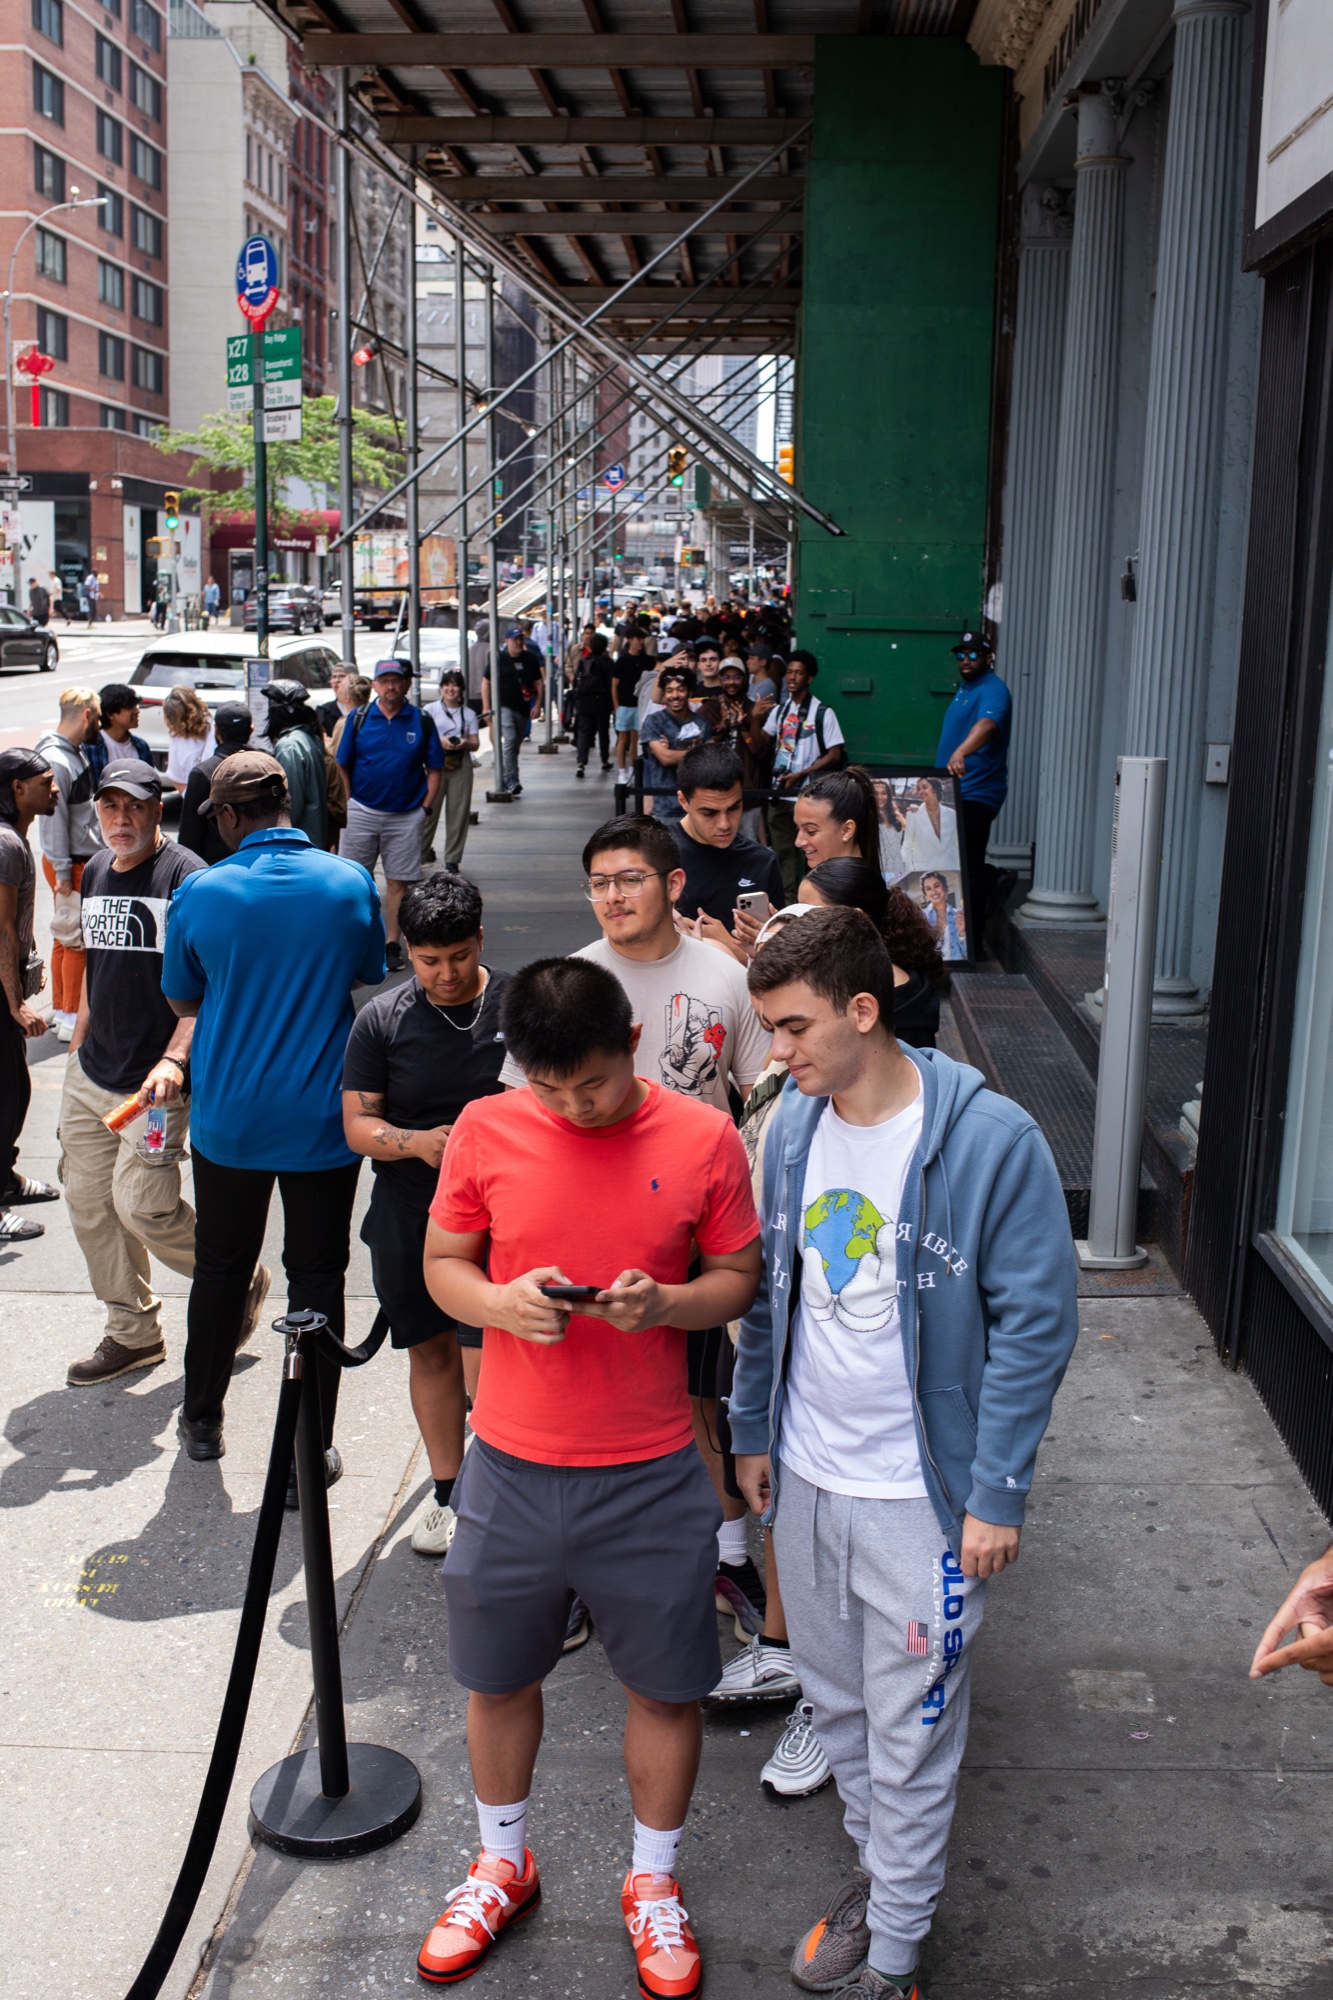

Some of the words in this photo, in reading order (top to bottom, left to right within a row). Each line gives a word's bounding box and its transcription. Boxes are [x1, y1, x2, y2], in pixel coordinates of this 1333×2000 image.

[103, 899, 130, 914] THE
[91, 930, 125, 947] FACE
[932, 1557, 941, 1628] RALPH
[941, 1542, 965, 1621] OLO
